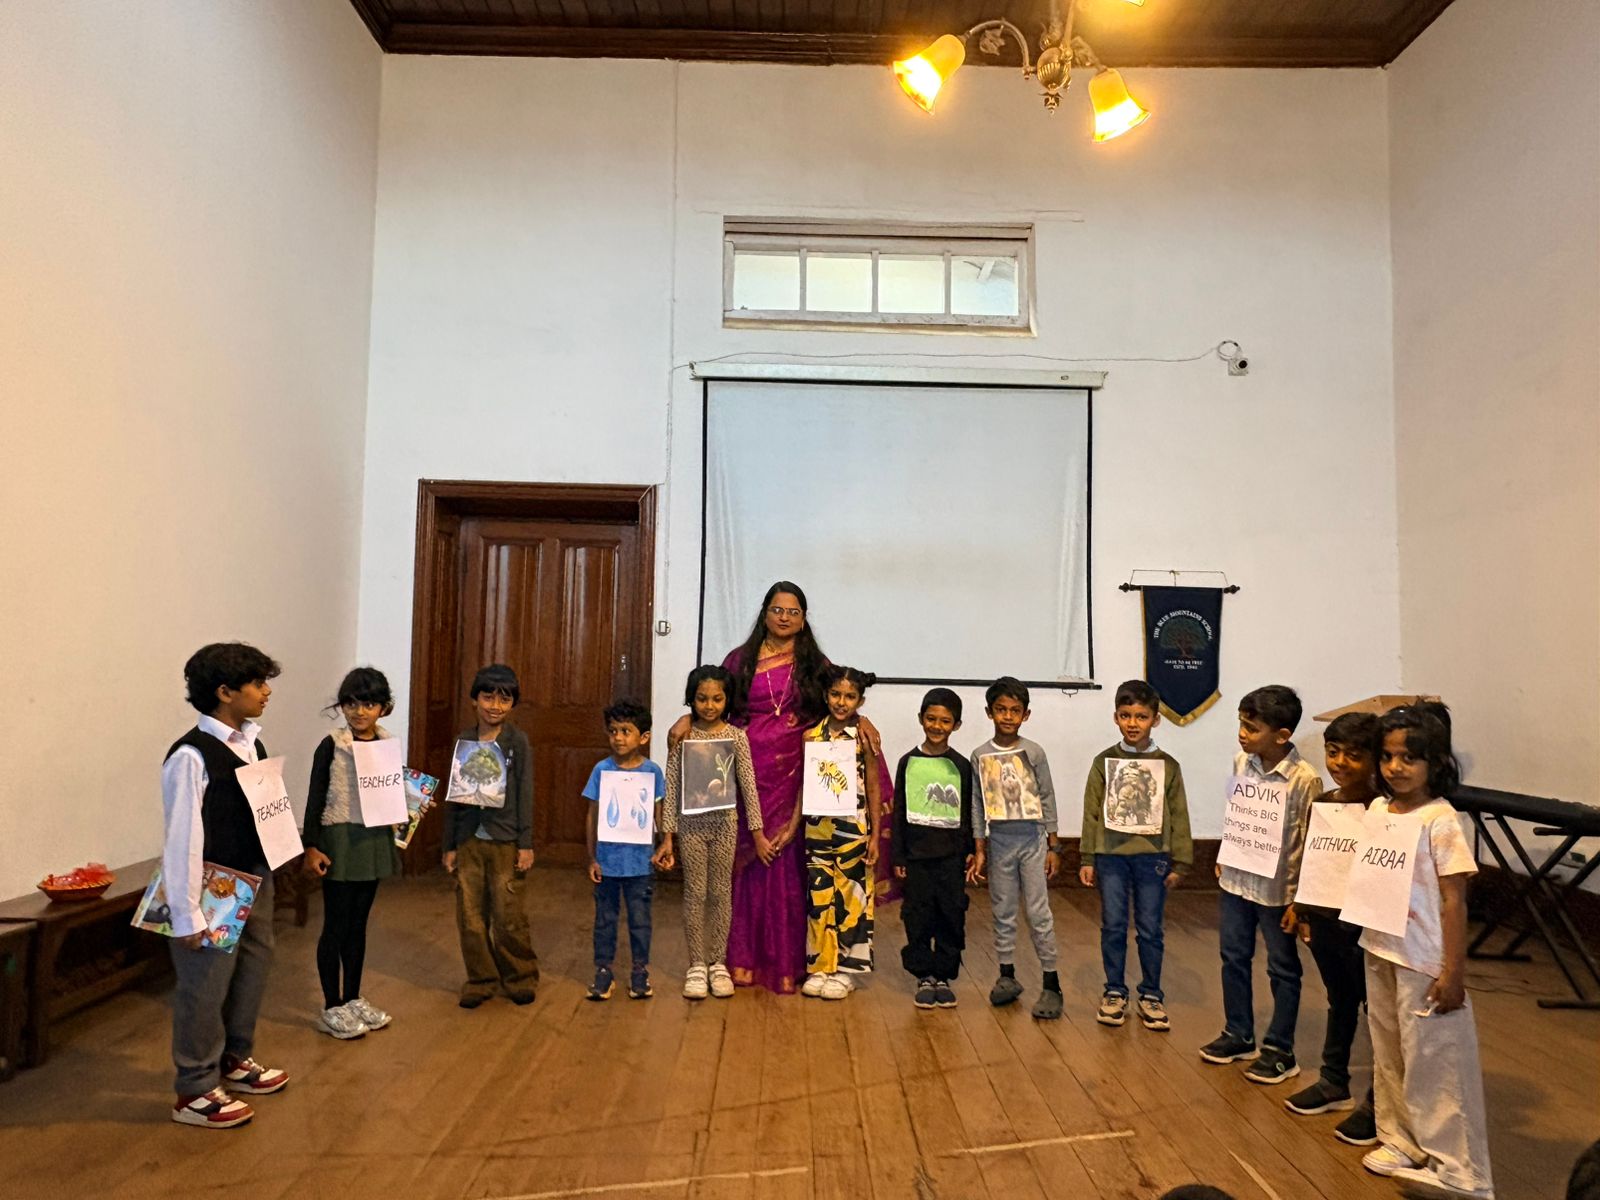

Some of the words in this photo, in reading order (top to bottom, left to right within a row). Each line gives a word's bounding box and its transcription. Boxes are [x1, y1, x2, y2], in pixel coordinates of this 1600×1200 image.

[359, 773, 401, 789] TEACHER
[1233, 783, 1280, 805] ADVIK
[256, 796, 291, 823] TEACHER
[1229, 801, 1258, 817] Thinks
[1260, 809, 1279, 822] BIG
[1224, 816, 1251, 832] things
[1252, 824, 1268, 835] are
[1223, 832, 1252, 847] always
[1254, 840, 1282, 853] better
[1308, 836, 1358, 854] NITHVIK
[1361, 846, 1407, 870] AIRAA
